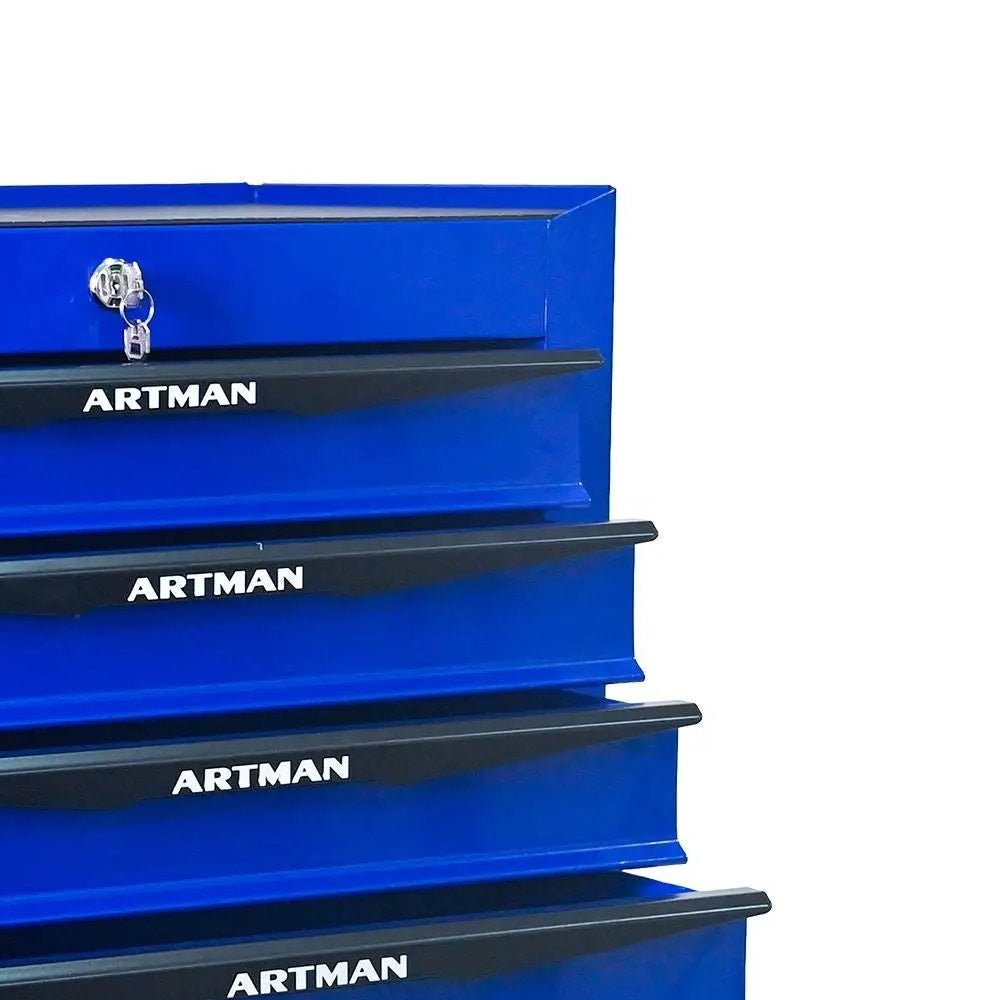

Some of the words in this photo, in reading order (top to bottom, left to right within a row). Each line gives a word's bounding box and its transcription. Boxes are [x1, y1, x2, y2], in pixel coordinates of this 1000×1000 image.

[83, 382, 256, 412] ARTMAN
[128, 567, 302, 601] ARTMAN
[172, 756, 348, 794] ARTMAN
[227, 955, 407, 998] ARTMAN
